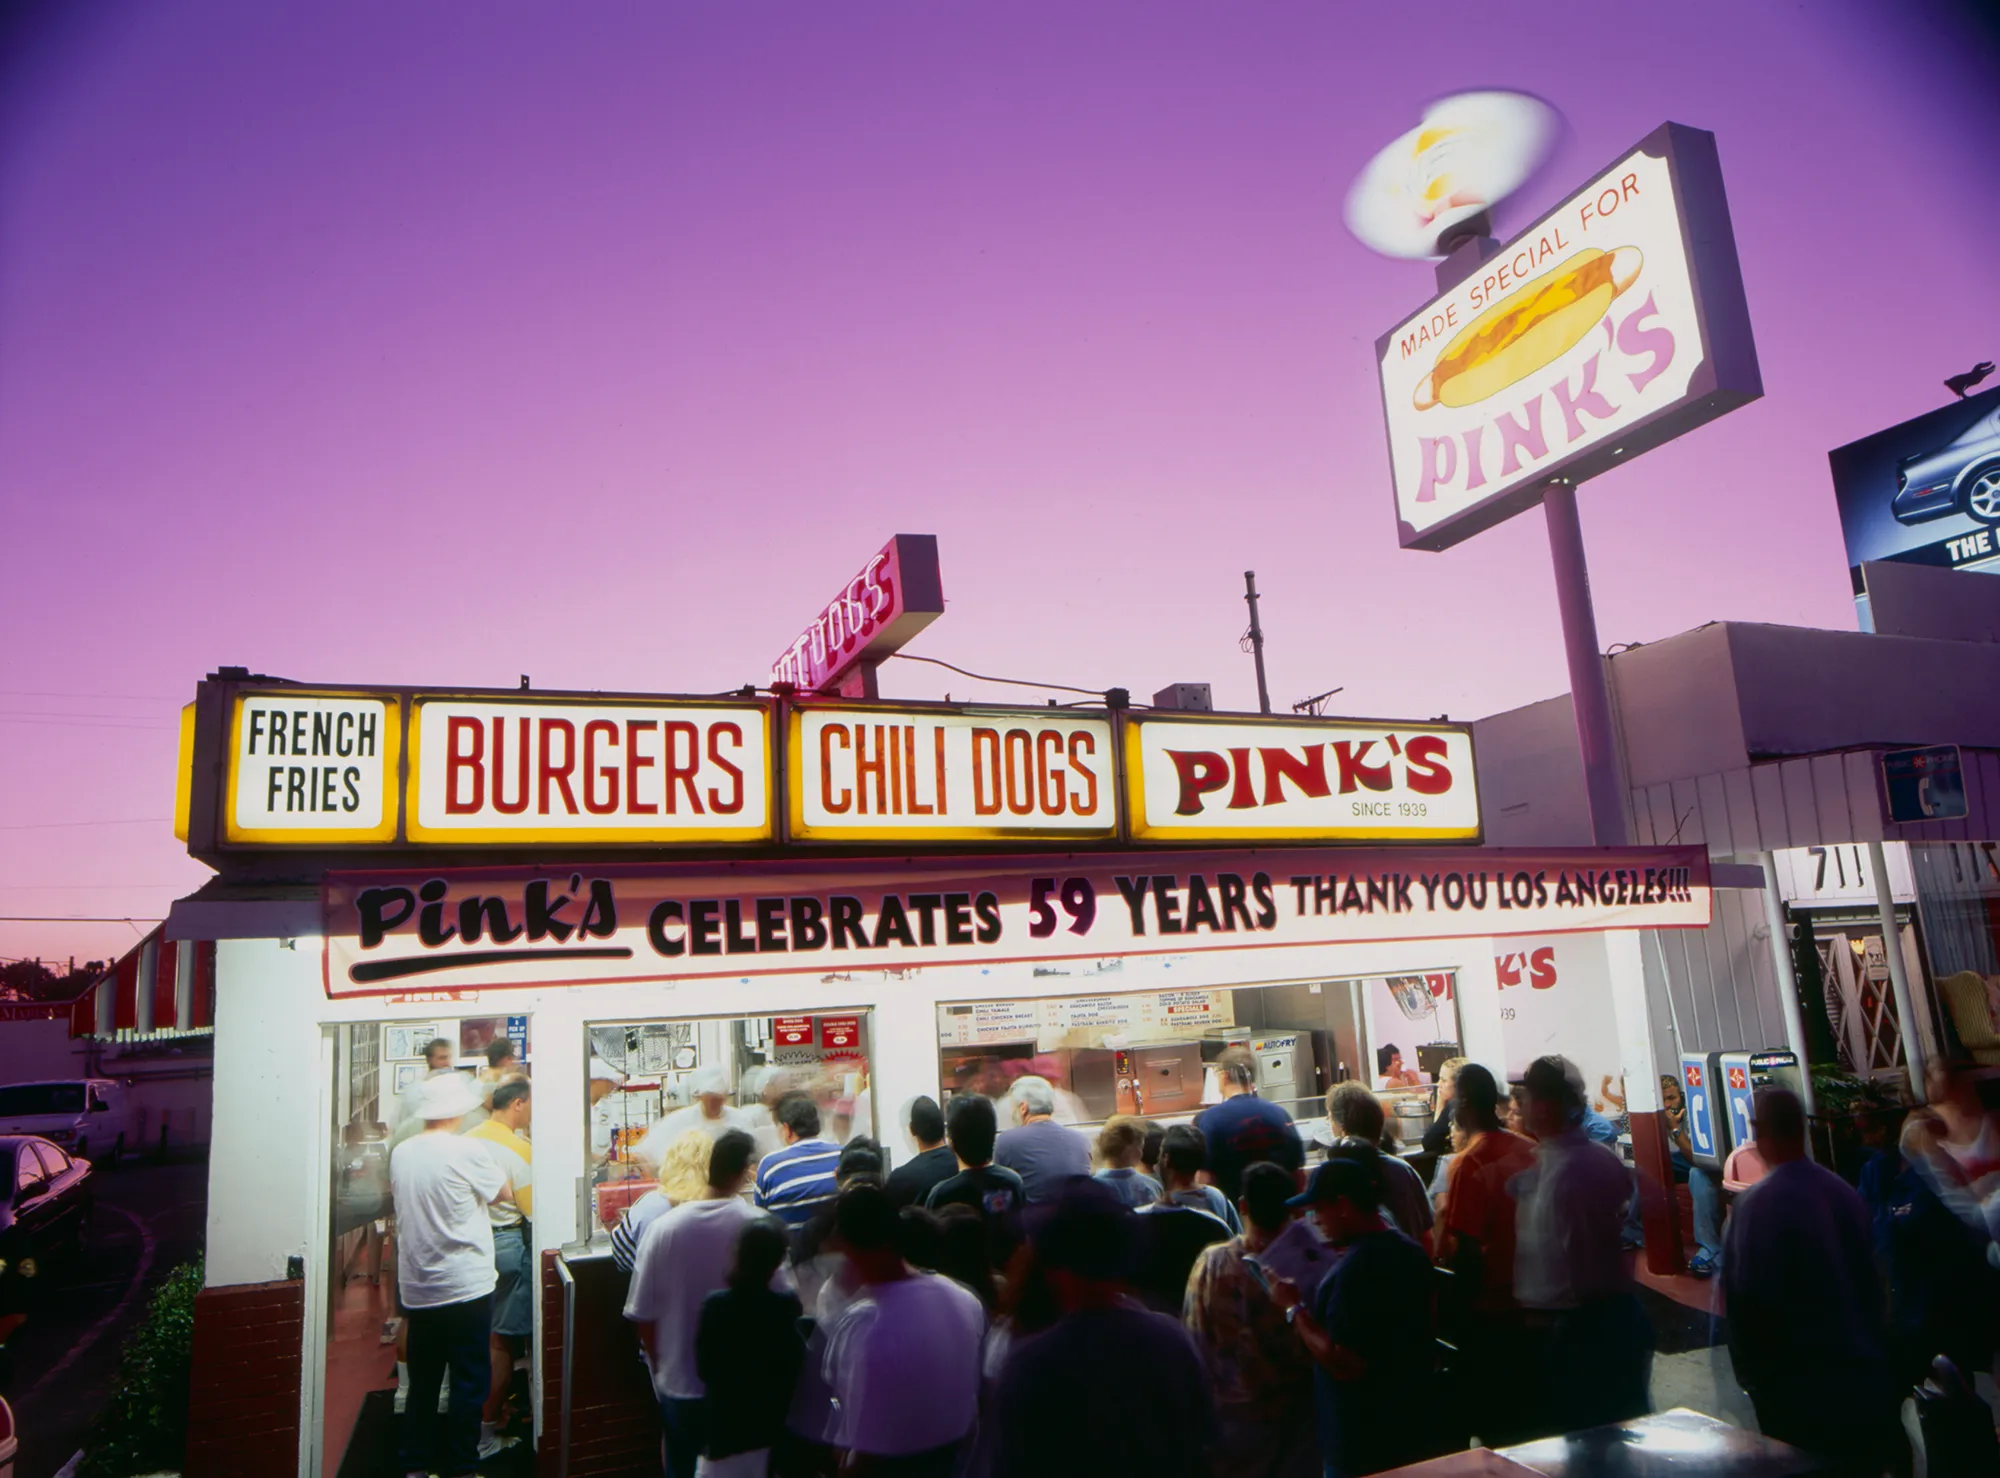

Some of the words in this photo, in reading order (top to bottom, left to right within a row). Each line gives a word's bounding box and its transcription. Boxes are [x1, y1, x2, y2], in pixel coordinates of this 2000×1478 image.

[1400, 303, 1459, 360] MADE
[1469, 228, 1569, 310] SPECIAL
[1579, 172, 1641, 232] FOR
[1414, 289, 1676, 502] PINK'S
[1945, 529, 1993, 562] THE
[248, 709, 377, 757] FRENCH
[444, 714, 745, 816] BURGERS
[267, 766, 361, 813] FRIES
[819, 723, 951, 816] CHILI
[970, 726, 1099, 817] DOGS
[1160, 732, 1454, 817] PINK'S
[1351, 801, 1392, 817] SINCE
[1397, 801, 1428, 818] 1939
[1808, 845, 1865, 892] 711
[355, 872, 618, 950] Pink's
[646, 890, 1002, 958] CELEBRATES
[1028, 876, 1098, 940] 59
[1112, 871, 1278, 938] YEARS
[1289, 873, 1414, 916] THANK
[1418, 870, 1489, 912] YOU
[1496, 869, 1549, 910] LOS
[1554, 866, 1693, 908] ANGELES!!!
[1262, 1037, 1297, 1052] AUTOFRY
